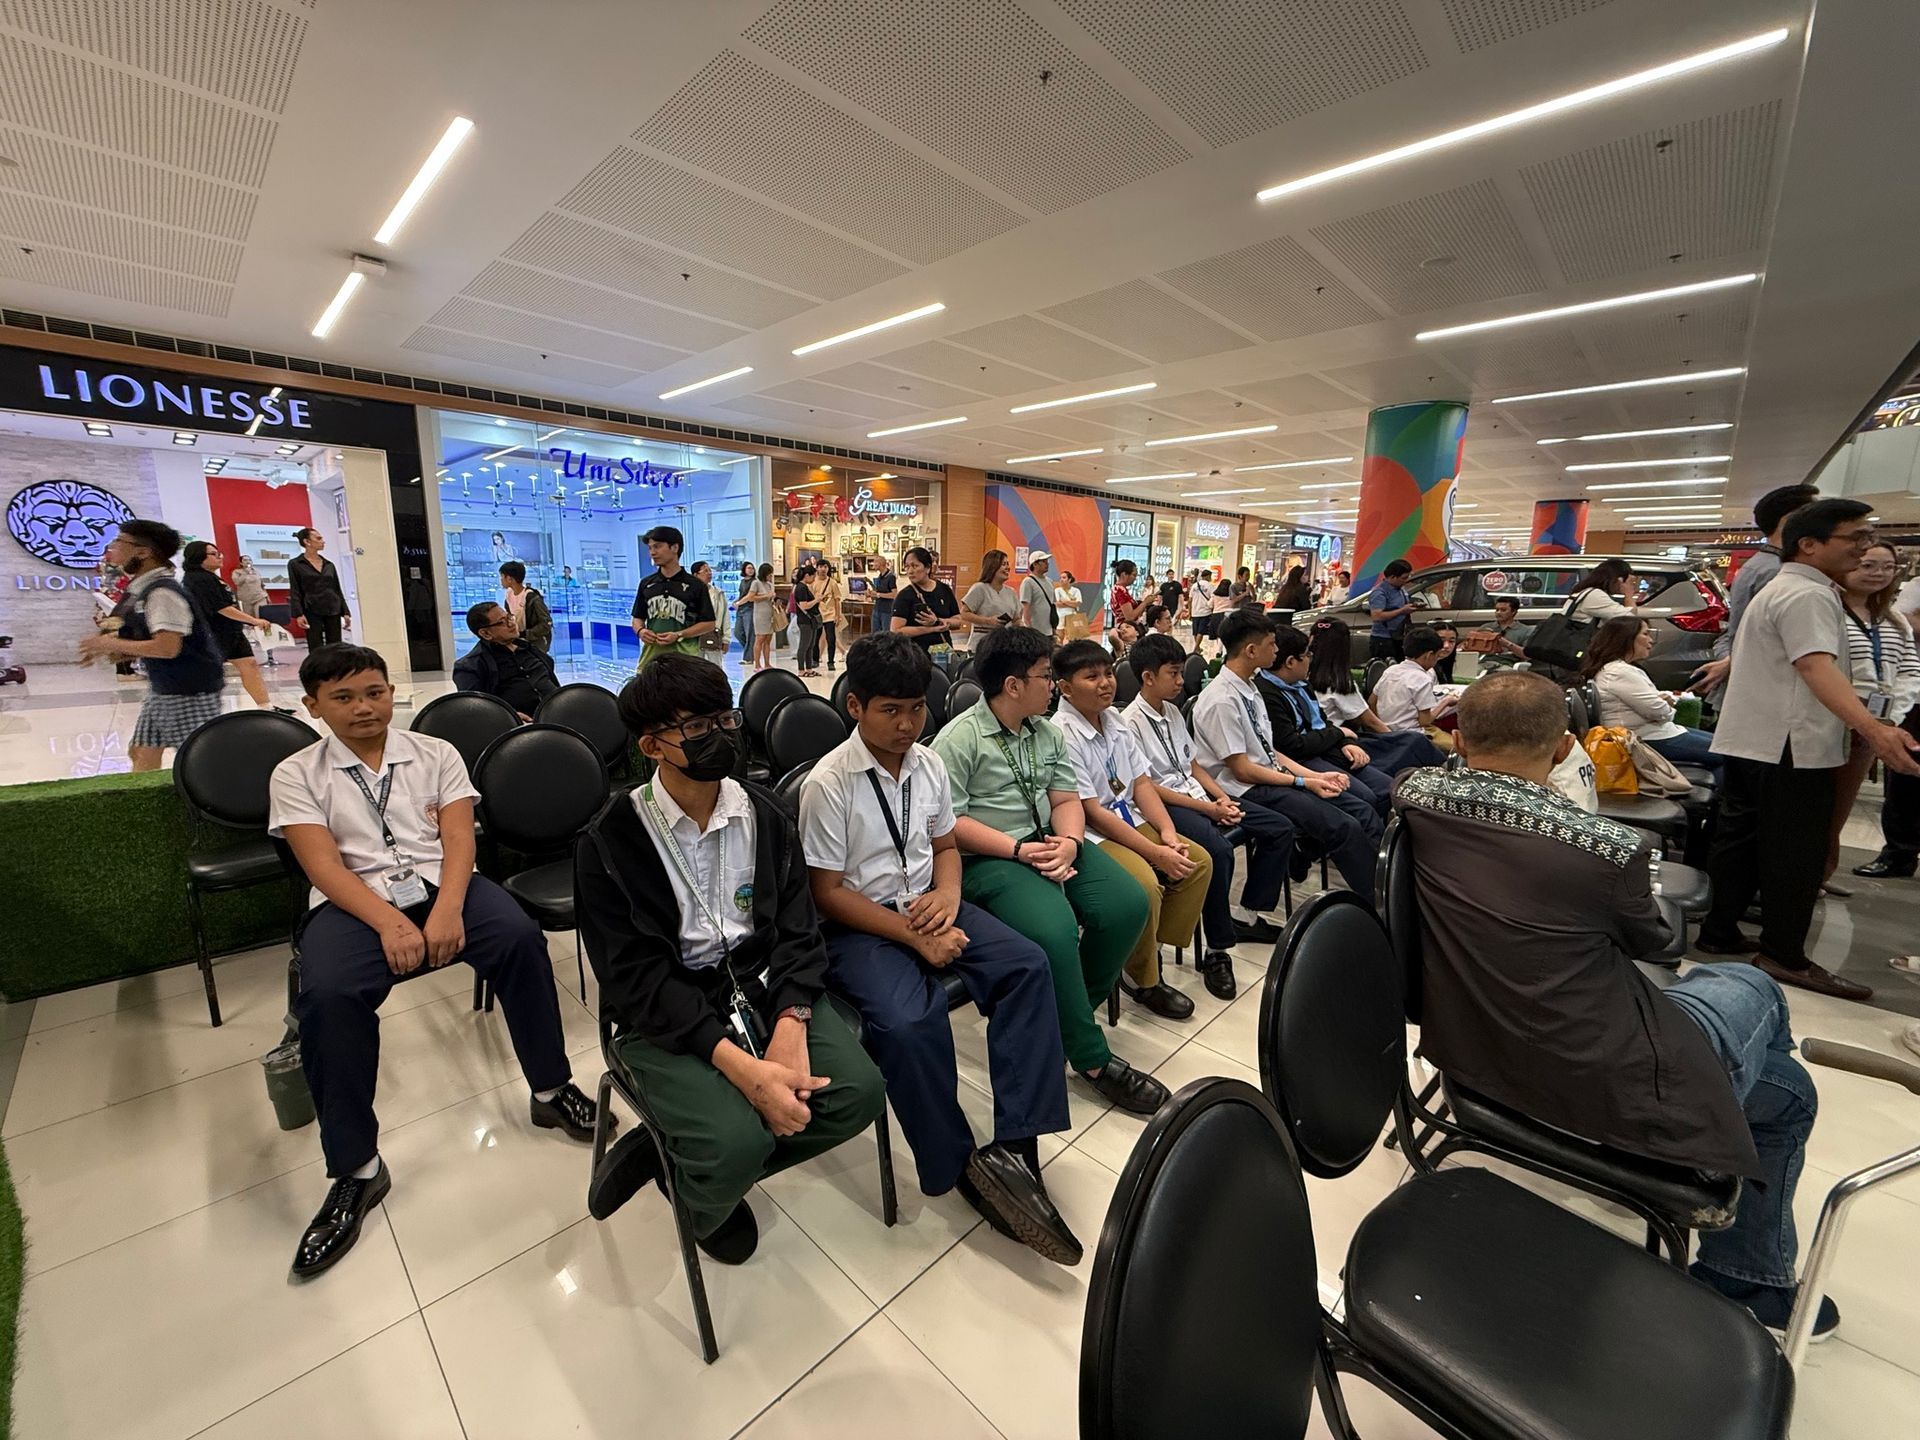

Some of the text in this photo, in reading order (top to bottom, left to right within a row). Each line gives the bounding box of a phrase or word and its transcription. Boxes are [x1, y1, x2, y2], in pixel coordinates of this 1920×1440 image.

[38, 364, 313, 430] LIONESSE
[549, 447, 685, 489] UniSilver
[890, 502, 918, 516] IMAGE
[16, 575, 101, 590] LIONE
[1486, 577, 1504, 585] ZERO
